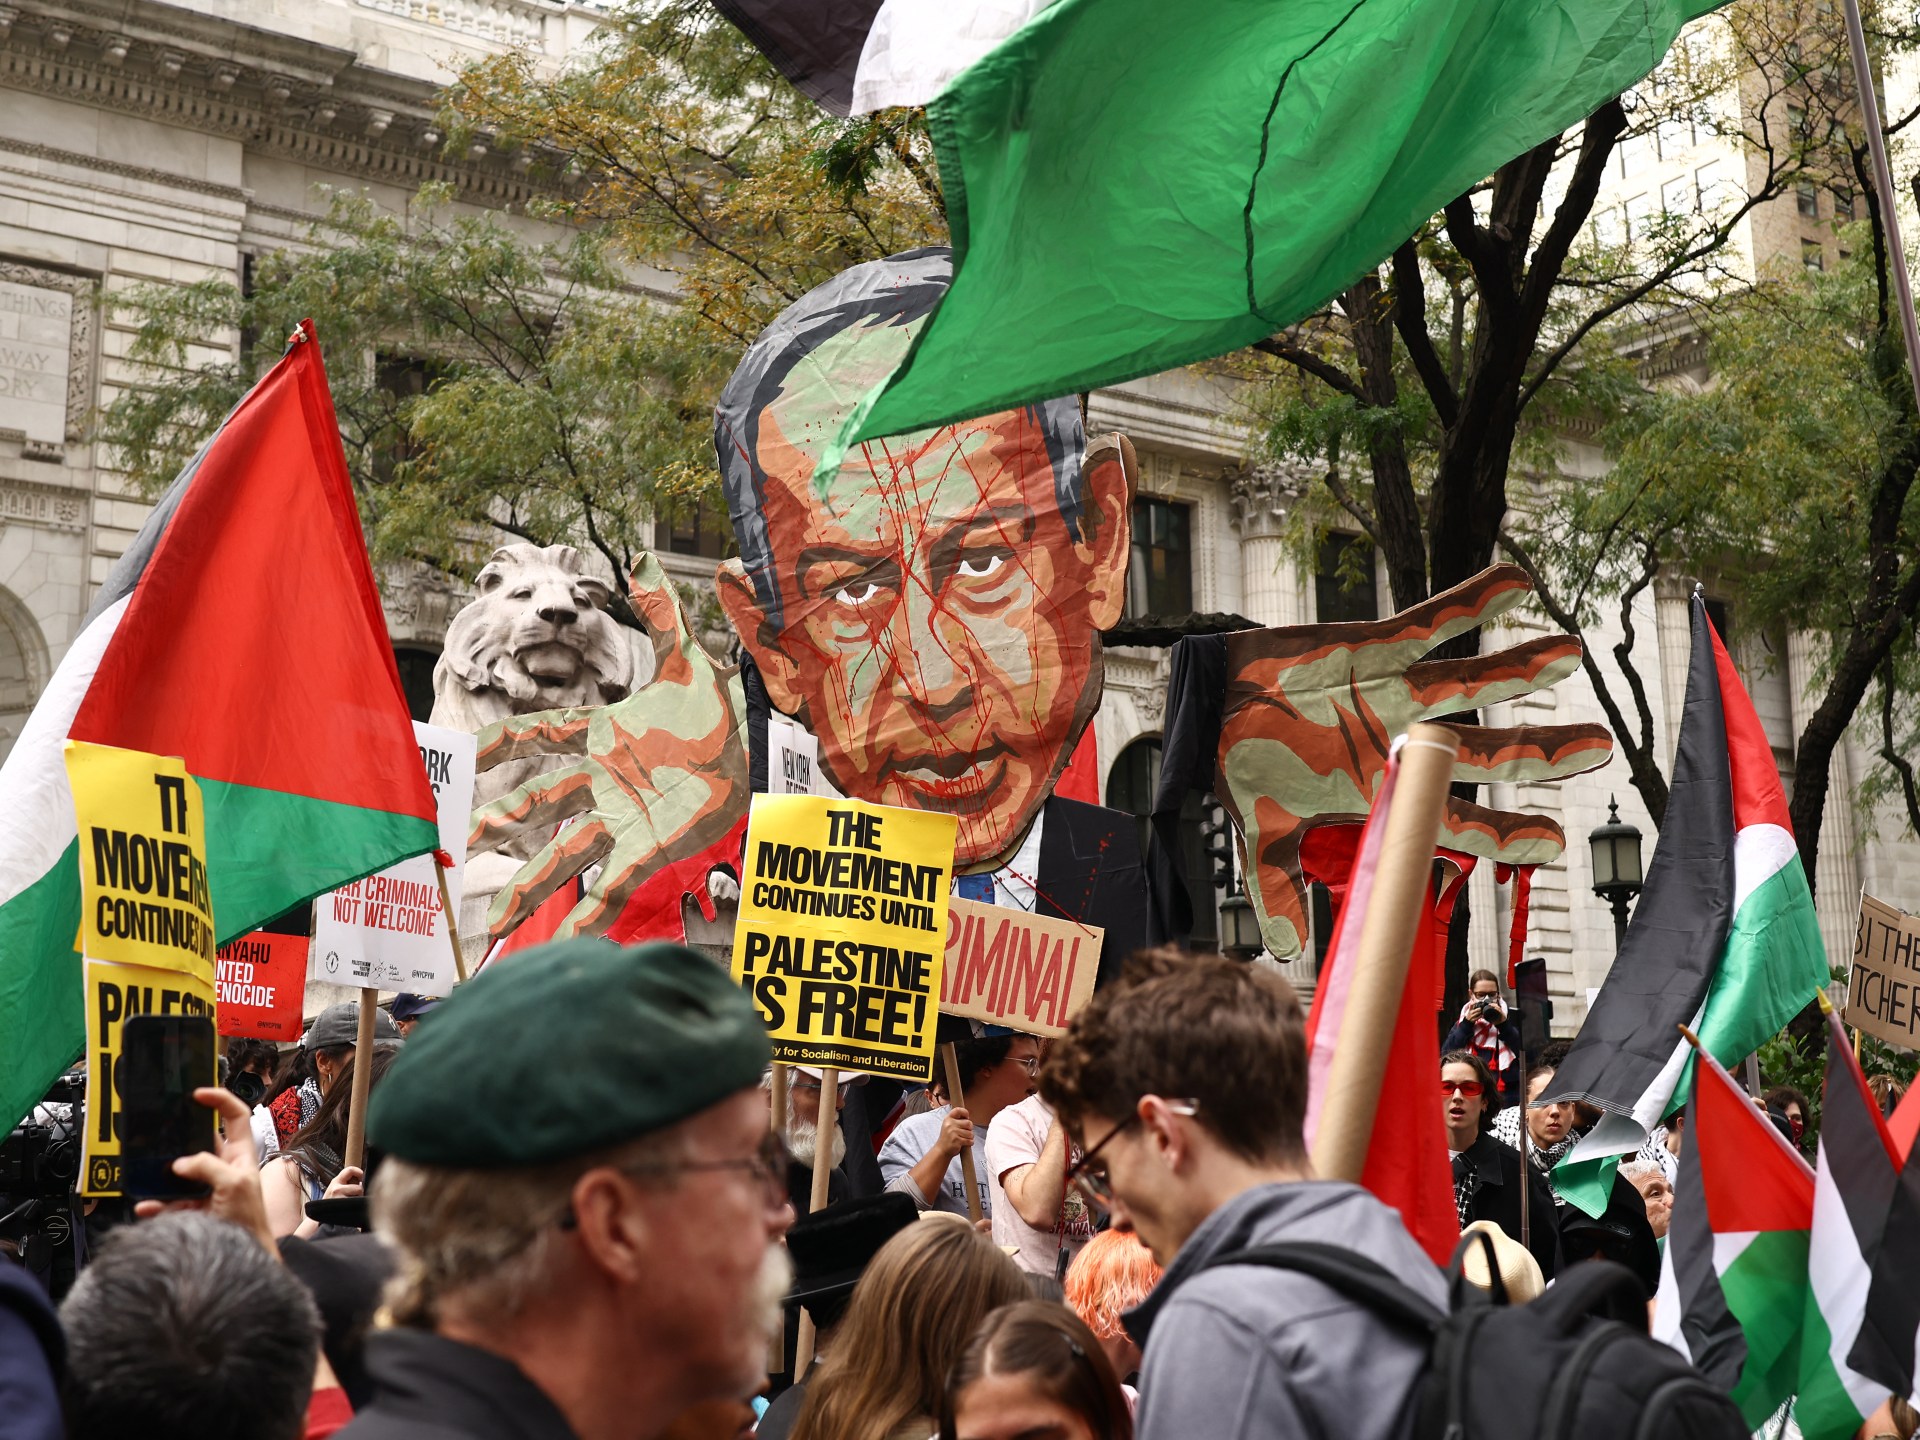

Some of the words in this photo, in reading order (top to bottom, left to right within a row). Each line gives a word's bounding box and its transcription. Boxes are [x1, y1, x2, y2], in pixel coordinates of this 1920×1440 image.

[1, 291, 66, 318] THINGS
[0, 347, 50, 370] WAY
[782, 746, 795, 780] NEW
[795, 751, 811, 787] YORK
[827, 810, 883, 852] THE
[756, 841, 943, 902] MOVEMENT
[365, 875, 444, 912] CRIMINALS
[753, 883, 876, 921] CONTINUES
[880, 899, 938, 932] UNTIL
[333, 896, 361, 925] NOT
[364, 901, 437, 937] WELCOME
[216, 960, 254, 984] NTED
[743, 931, 933, 993] PALESTINE
[940, 909, 1081, 1028] RIMINAL
[215, 981, 275, 1008] ENOCIDE
[797, 980, 927, 1049] FREE!
[1850, 963, 1920, 1035] TCHER
[783, 1046, 799, 1057] for
[801, 1048, 850, 1062] Socialism
[852, 1055, 872, 1065] and
[874, 1056, 926, 1073] Liberation
